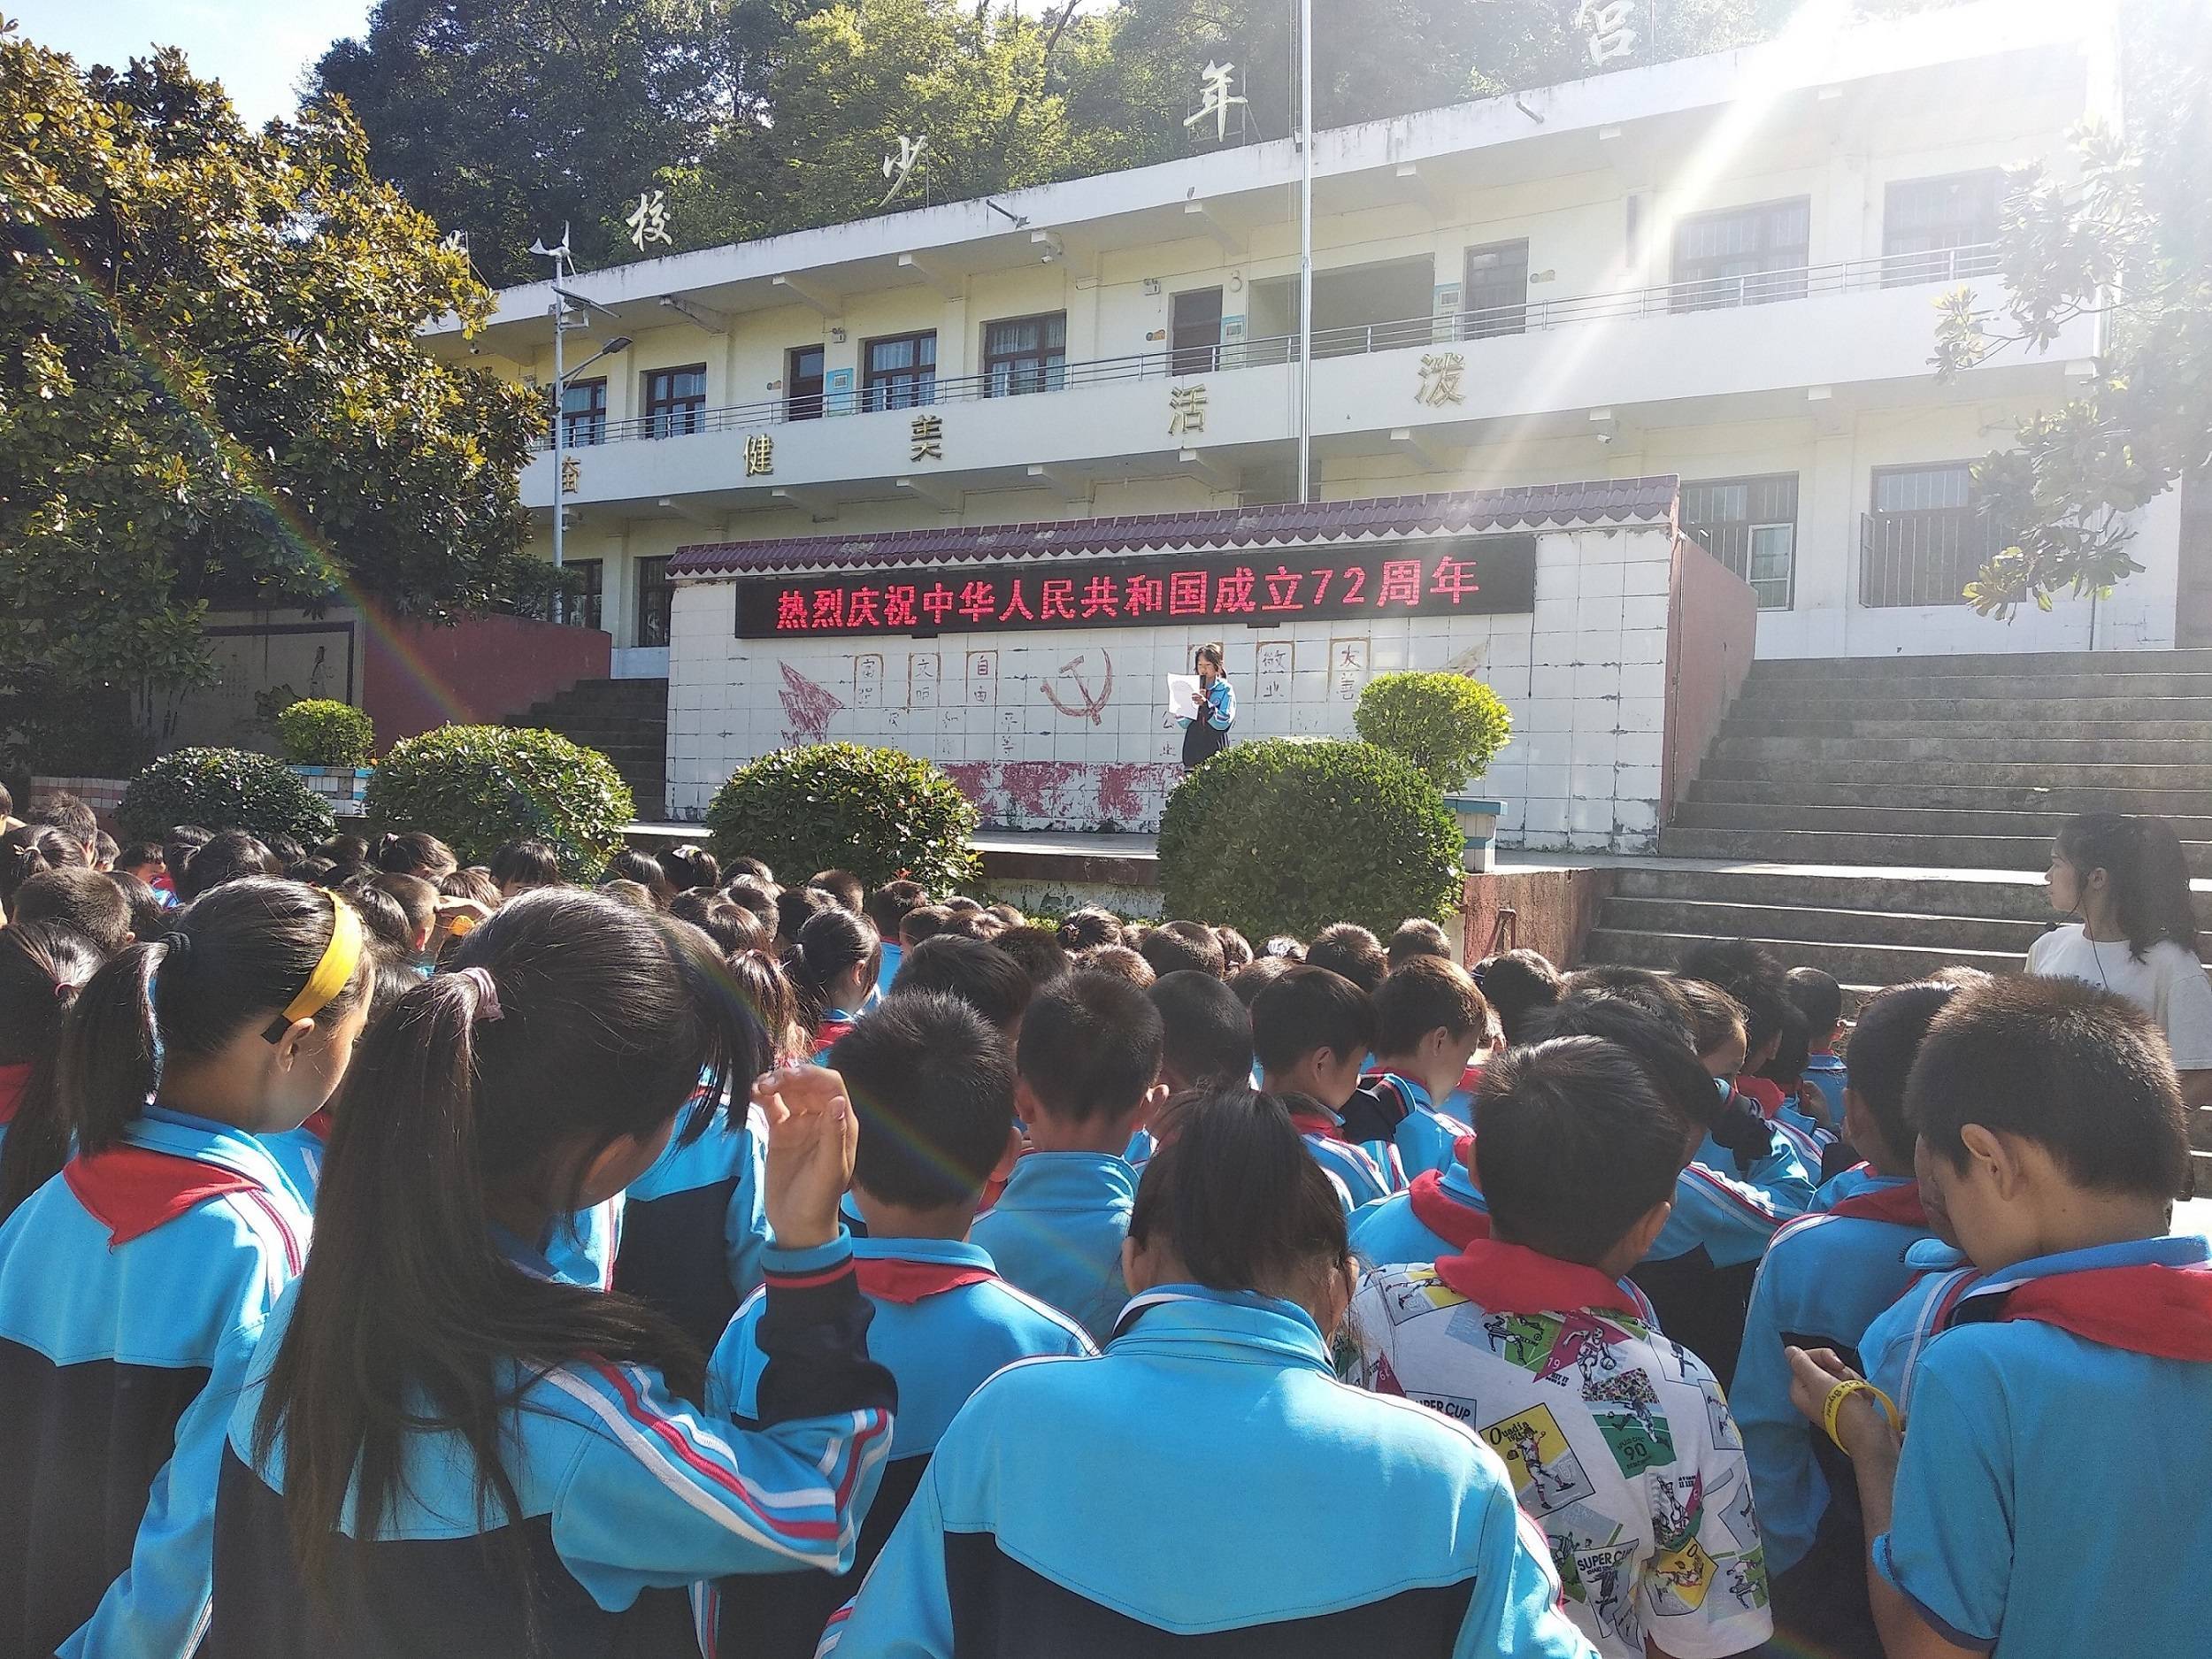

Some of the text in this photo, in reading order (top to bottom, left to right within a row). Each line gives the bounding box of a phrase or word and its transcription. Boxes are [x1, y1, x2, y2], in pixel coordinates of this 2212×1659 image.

[777, 554, 1479, 631] 热烈庆祝中华人民共和国成立72周年
[1446, 1402, 1471, 1420] CUP
[1577, 1552, 1612, 1571] SUPER
